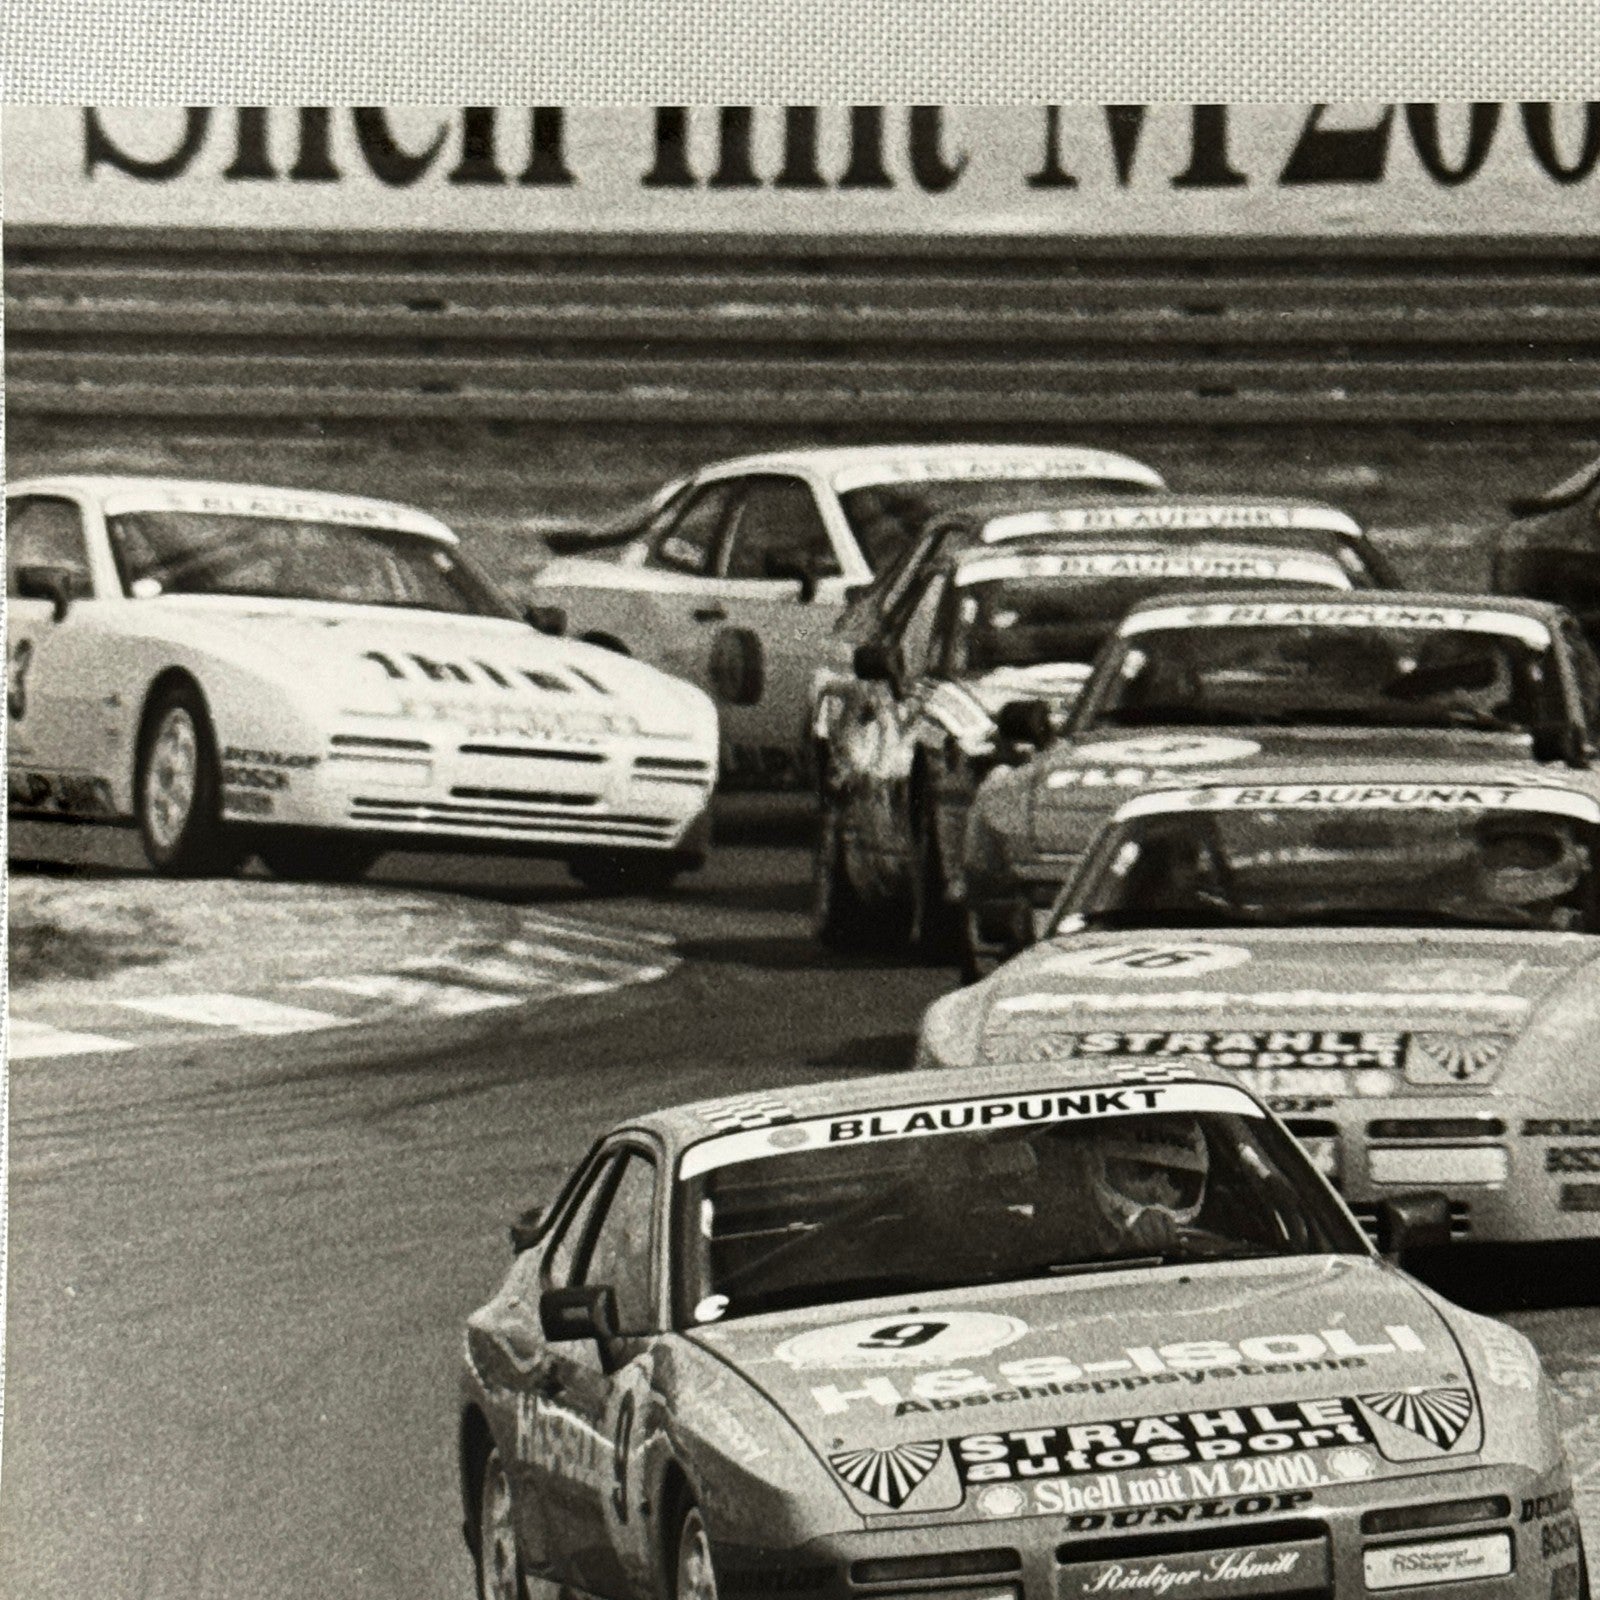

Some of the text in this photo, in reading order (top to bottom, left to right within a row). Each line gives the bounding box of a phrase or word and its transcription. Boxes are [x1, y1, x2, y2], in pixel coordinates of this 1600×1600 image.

[1234, 788, 1520, 805] BLAUPUNKT
[829, 1089, 1167, 1143] BLAUPUNKT
[857, 1322, 950, 1348] 9
[958, 1398, 1357, 1463] STRÄHLE
[966, 1422, 1366, 1482] autosport
[1034, 1474, 1122, 1515] Shell
[1128, 1472, 1181, 1505] mit
[1189, 1464, 1232, 1498] M
[1063, 1490, 1313, 1532] DUNLOP
[1082, 1561, 1202, 1595] Rüdiger
